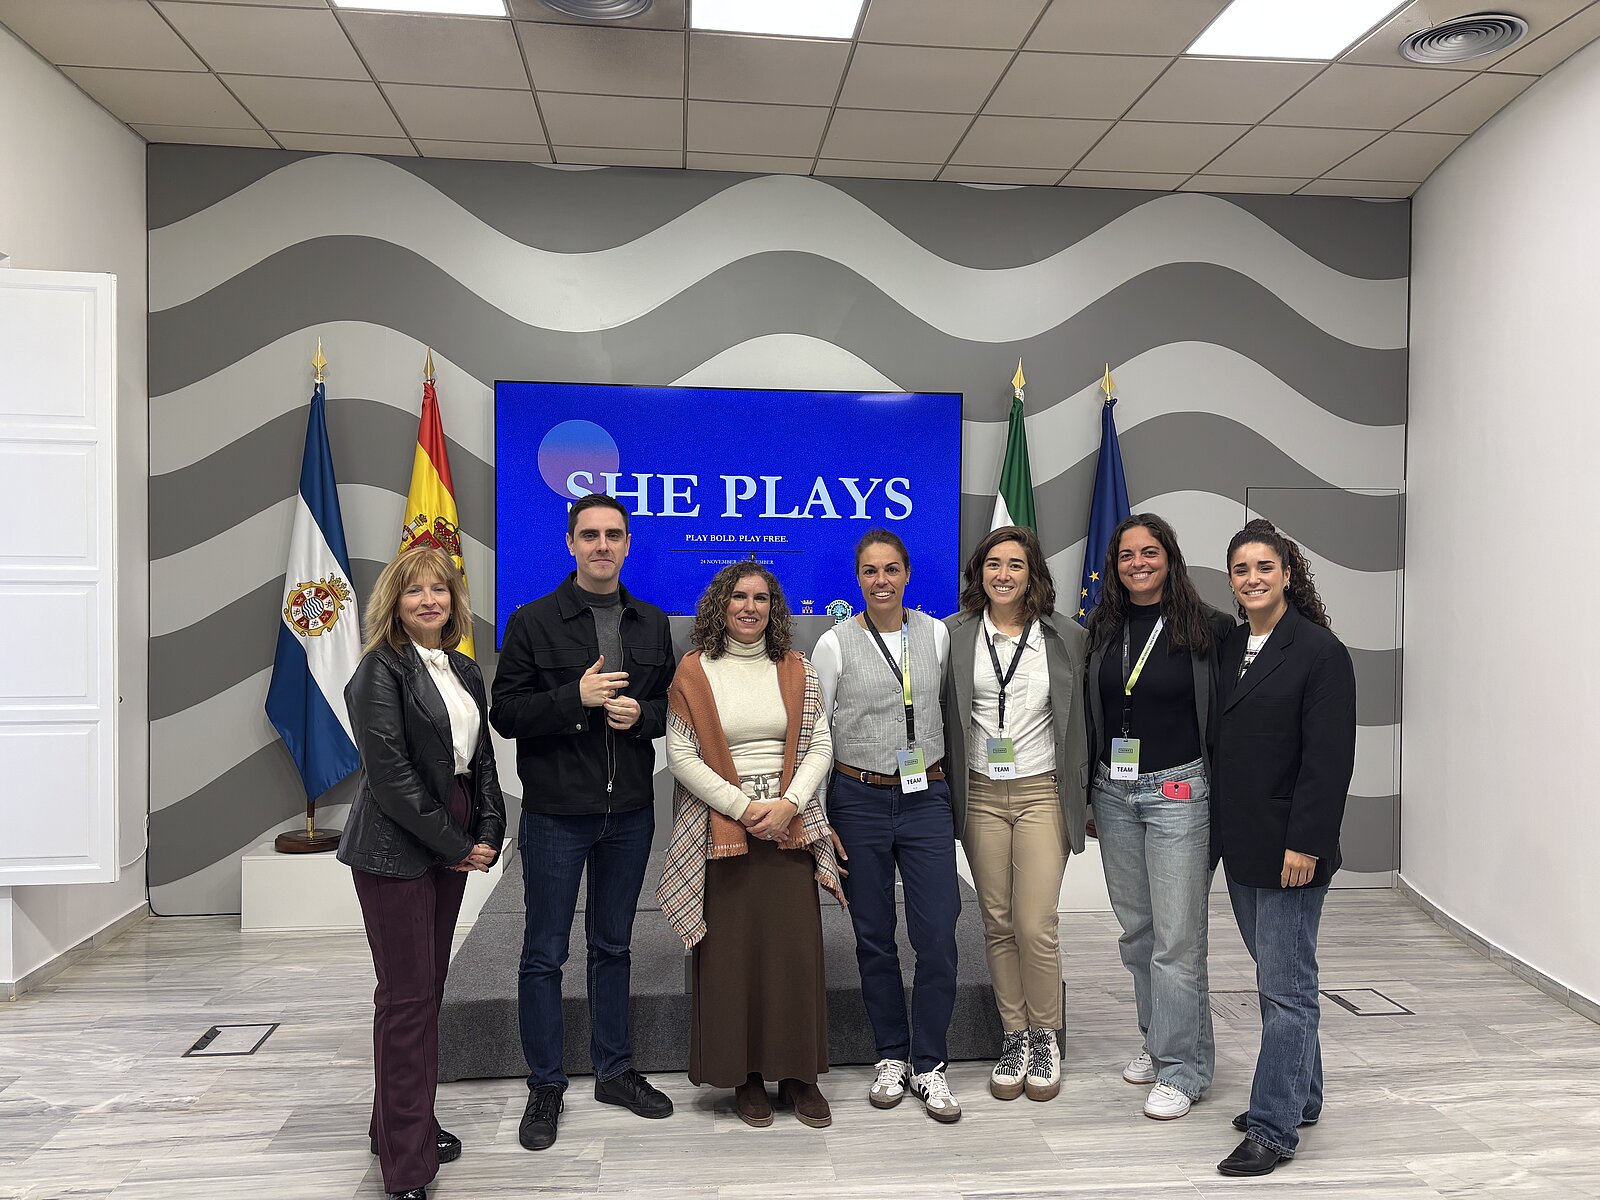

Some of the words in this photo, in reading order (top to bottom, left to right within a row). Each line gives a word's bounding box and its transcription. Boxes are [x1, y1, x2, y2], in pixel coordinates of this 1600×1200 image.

[566, 470, 700, 518] SHE
[719, 474, 913, 520] PLAYS
[685, 534, 708, 542] PLAY
[710, 534, 737, 542] BOLD.
[739, 535, 761, 543] PLAY
[763, 535, 789, 543] FREE.
[906, 777, 922, 785] TEAM
